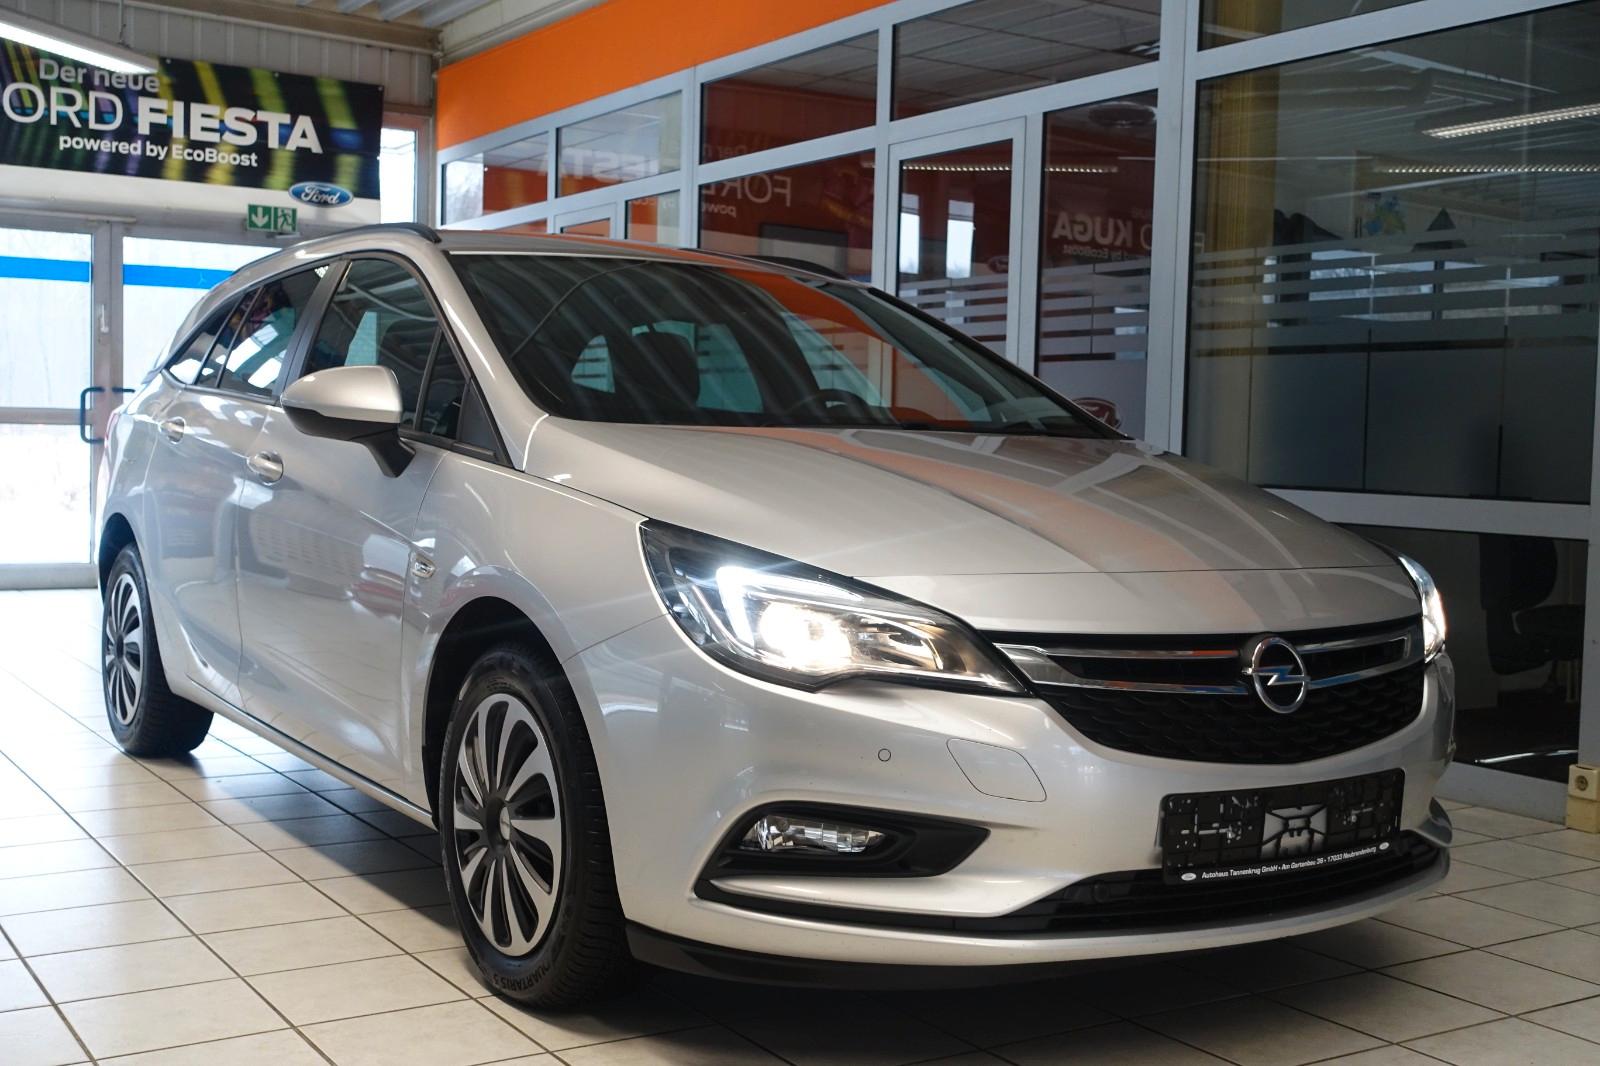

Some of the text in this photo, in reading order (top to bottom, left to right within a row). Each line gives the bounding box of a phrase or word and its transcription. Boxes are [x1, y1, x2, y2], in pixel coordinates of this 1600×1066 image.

[39, 57, 160, 93] Der neue
[2, 81, 324, 154] ORD FIESTA
[59, 134, 258, 167] powered by EcoBoost
[1201, 871, 1229, 880] Autohaus
[1261, 864, 1279, 873] GmbH
